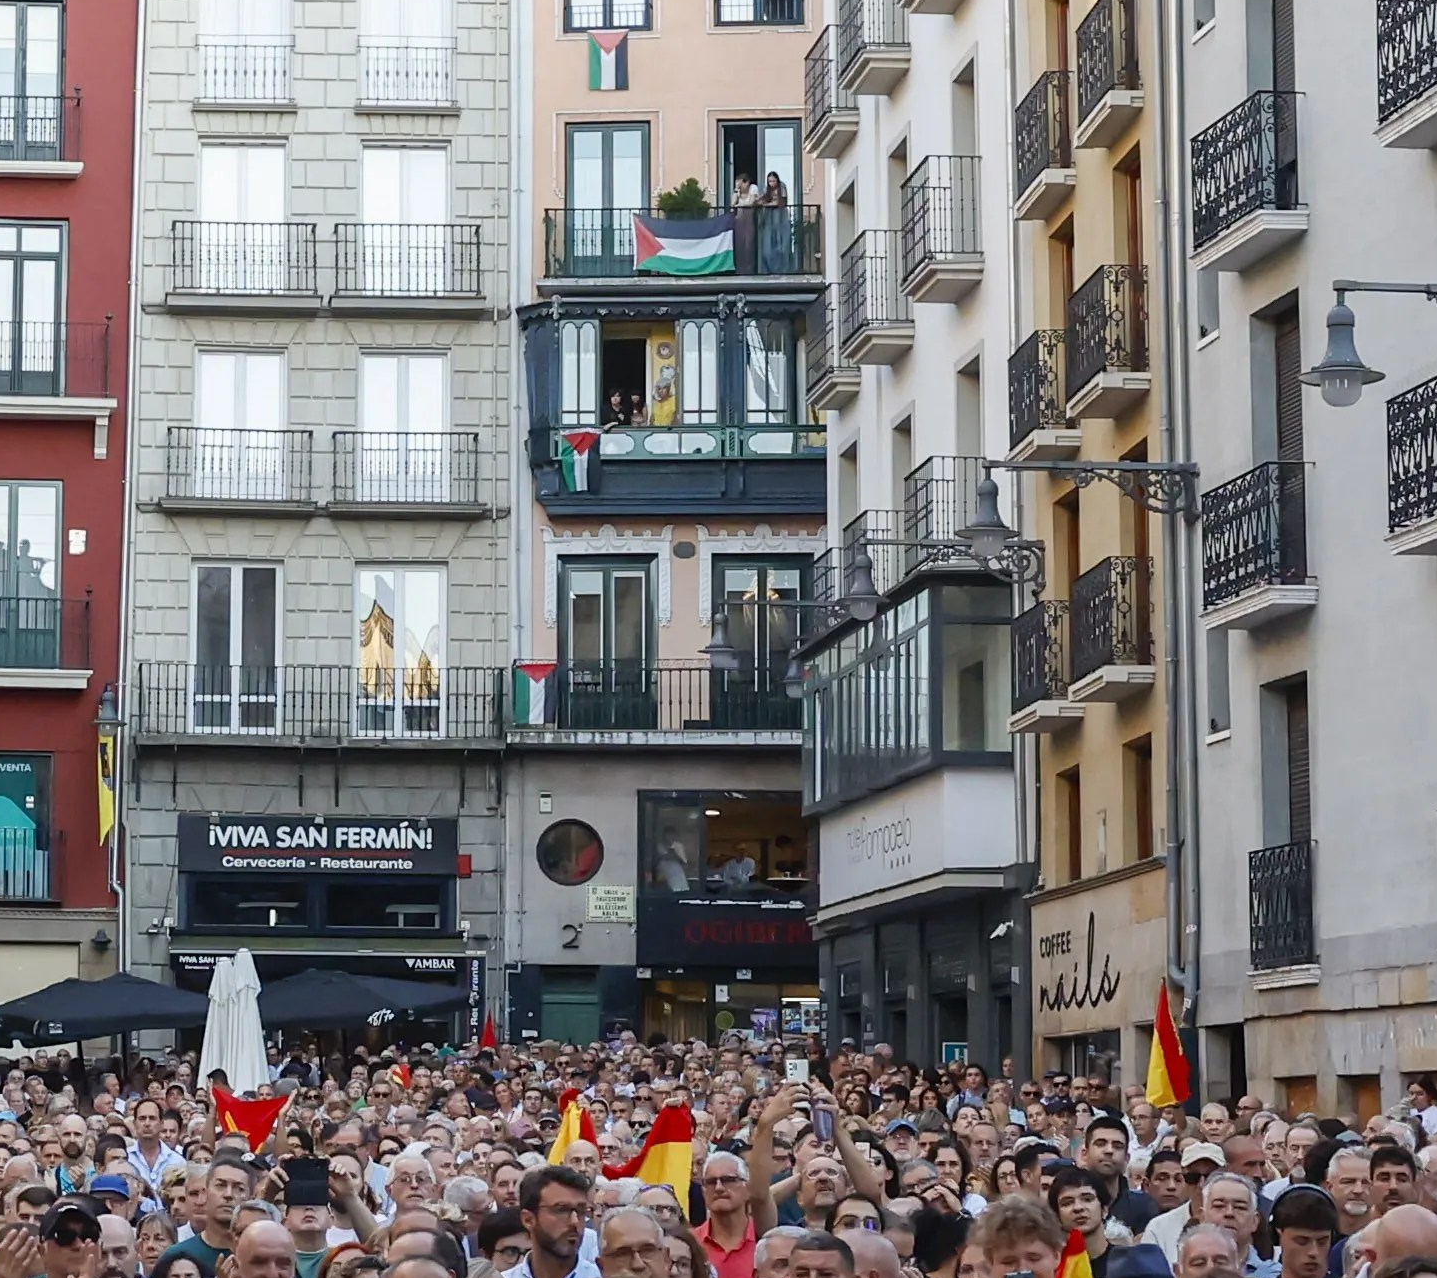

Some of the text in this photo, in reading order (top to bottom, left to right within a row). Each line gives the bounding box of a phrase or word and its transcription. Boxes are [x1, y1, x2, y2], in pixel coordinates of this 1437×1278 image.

[208, 821, 434, 851] ¡VIVA SAN FERMÍN!
[221, 855, 306, 869] Cervecería
[320, 856, 414, 870] Restaurante
[561, 923, 580, 949] 2
[1039, 930, 1071, 959] COFFEE
[198, 956, 215, 964] SAN
[414, 958, 456, 970] AMBAR
[1039, 911, 1121, 1012] nails
